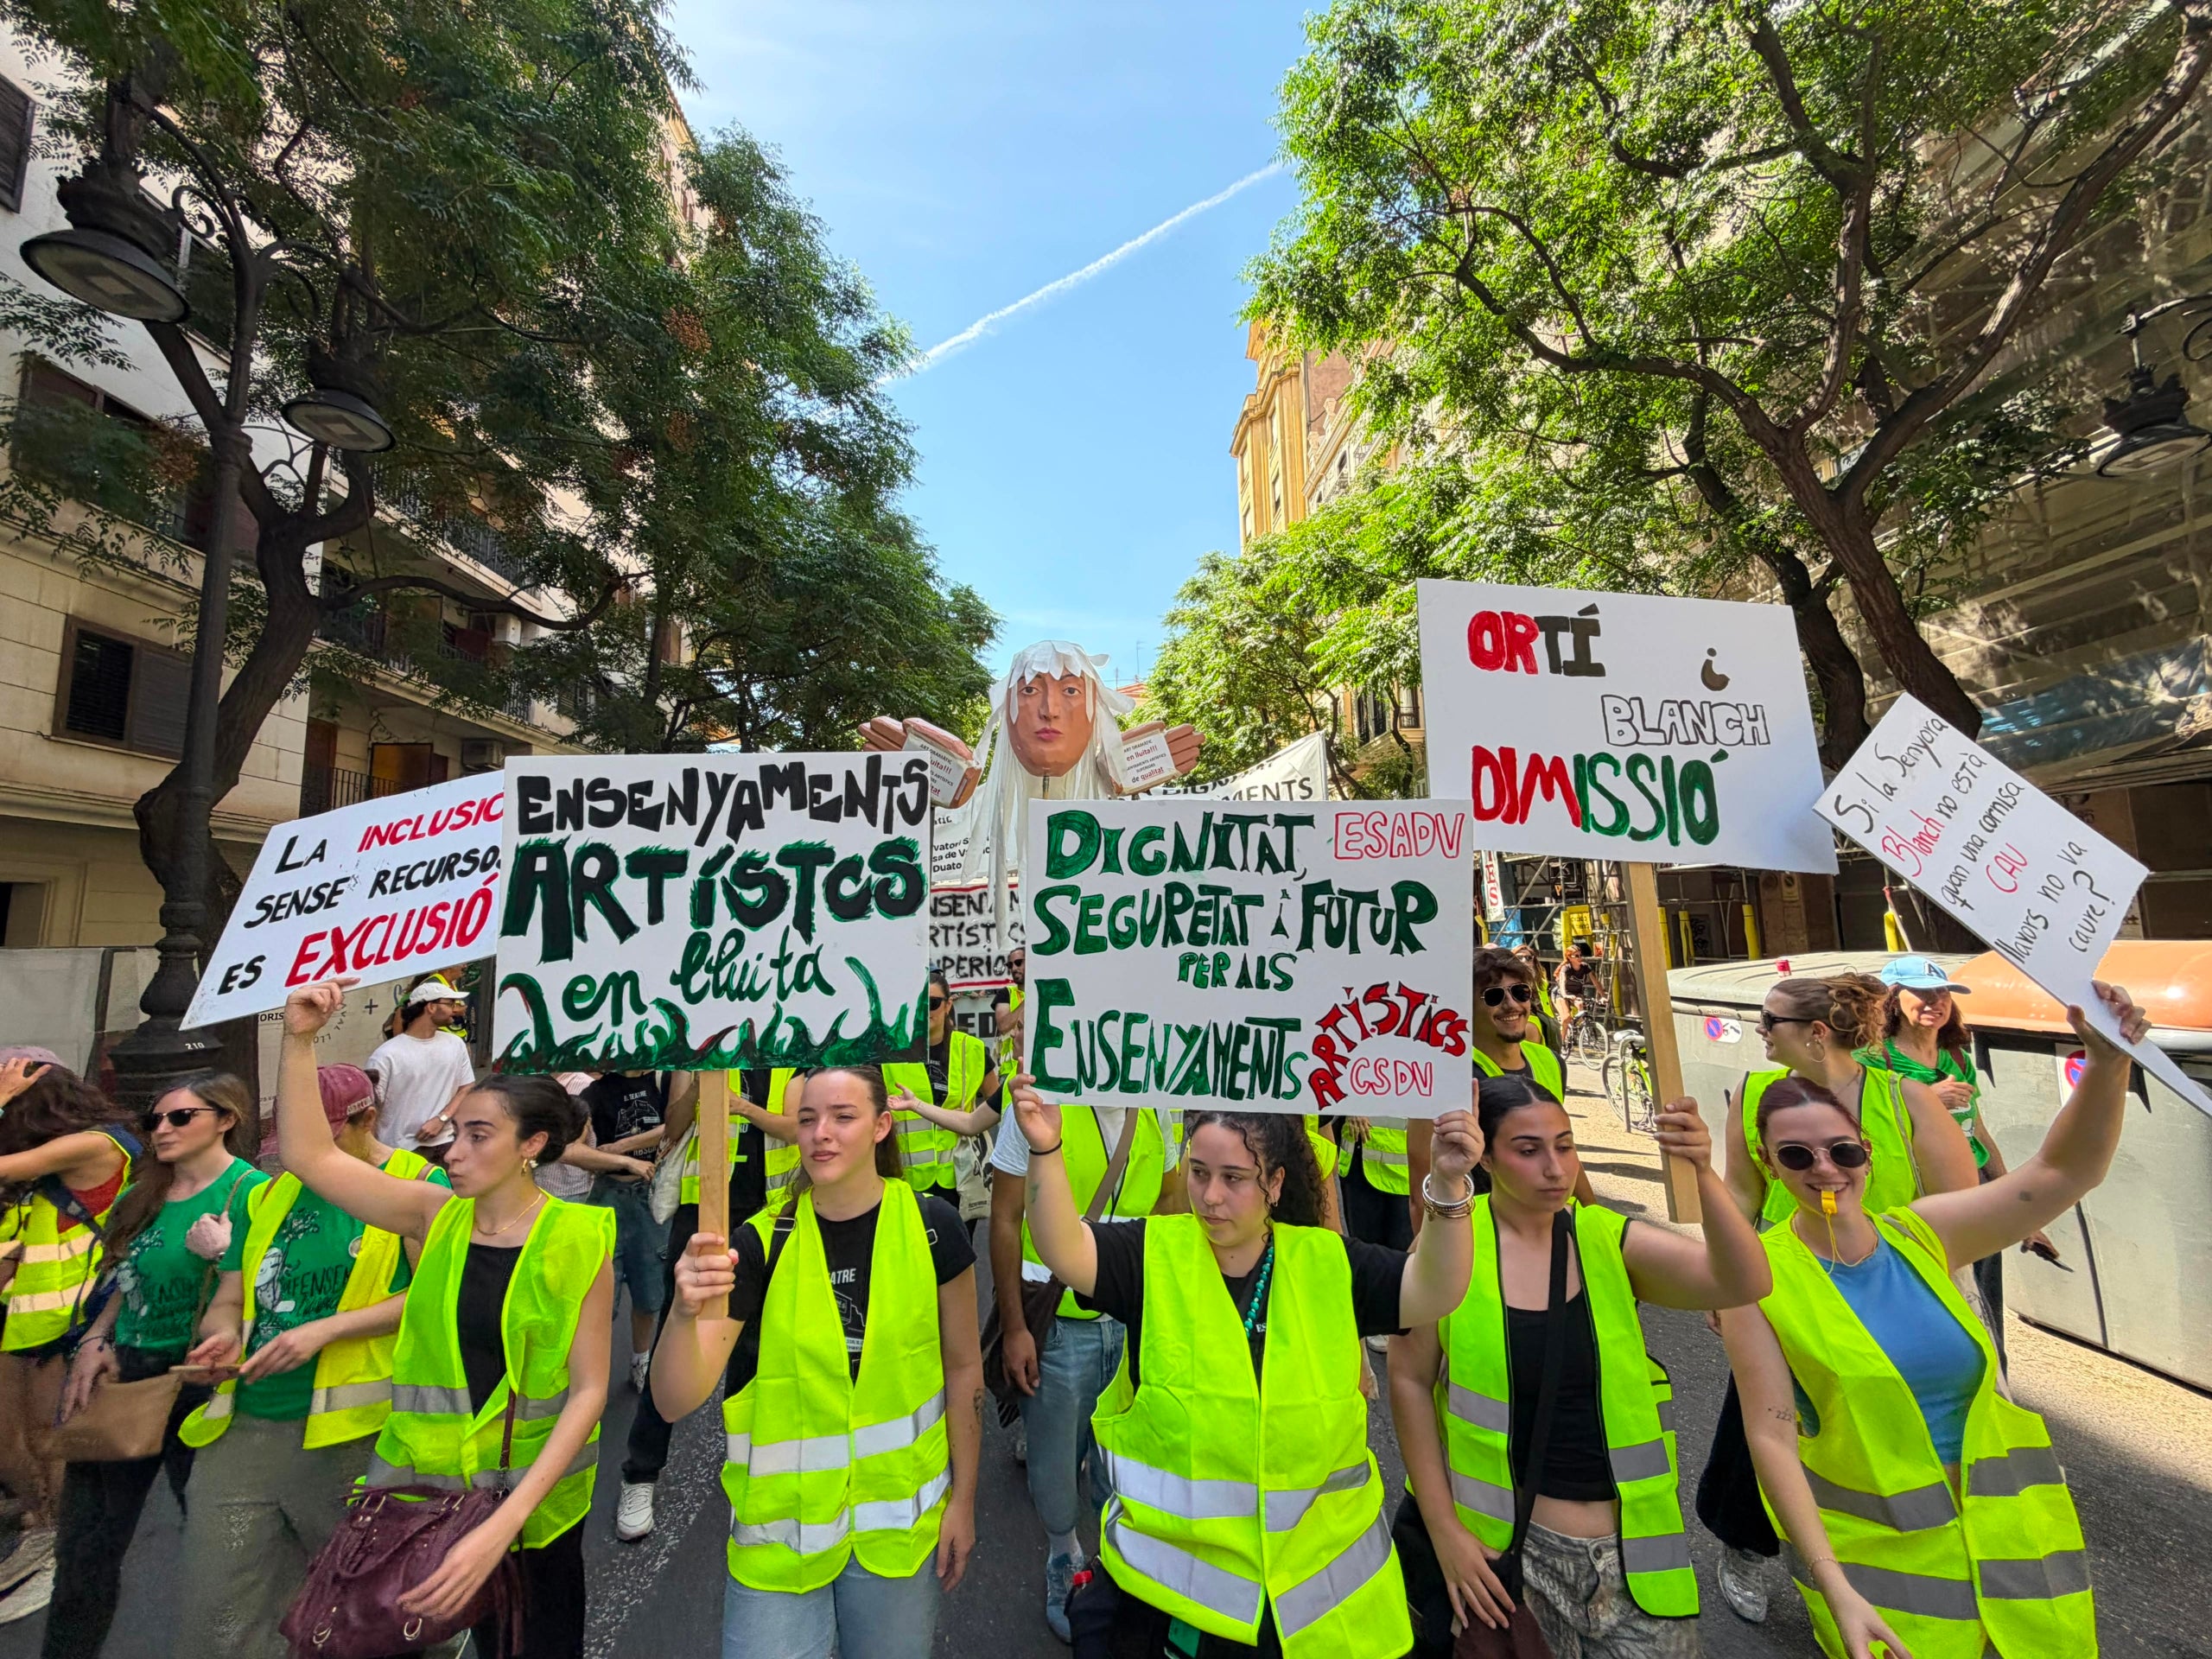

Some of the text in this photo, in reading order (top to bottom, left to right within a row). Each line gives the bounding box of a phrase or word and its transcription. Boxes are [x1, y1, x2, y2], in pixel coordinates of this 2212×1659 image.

[1467, 602, 1605, 677] ORTÍ
[1600, 694, 1770, 746] BLANCH
[518, 754, 929, 846] ENSENYAMENTS
[1140, 766, 1165, 781] qualitat
[1471, 745, 1729, 847] DIMISSIÓ
[1834, 718, 1948, 834] Si la Senyora
[932, 862, 963, 873] Duato
[1333, 811, 1465, 860] ESADV
[1881, 810, 1946, 877] Blanch
[1935, 794, 1958, 821] no
[1940, 781, 2025, 911] quan una cornisa
[1986, 842, 2028, 893] CAU
[244, 845, 501, 928] SENSE RECURSO
[1031, 884, 1265, 956] SEGURETAT
[1297, 879, 1439, 957] FUTUR
[1994, 907, 2049, 964] llavors
[2036, 873, 2066, 904] no
[2056, 841, 2088, 866] va
[2069, 869, 2116, 953] caure?
[218, 872, 499, 995] ES EXCLUSIÓ
[1177, 951, 1298, 991] PER ALS
[1923, 961, 1945, 980] A
[562, 925, 836, 1027] en lluita
[184, 1042, 206, 1051] 210
[1028, 977, 1308, 1101] ENSENYAMENTS
[1349, 1056, 1434, 1097] CSDV
